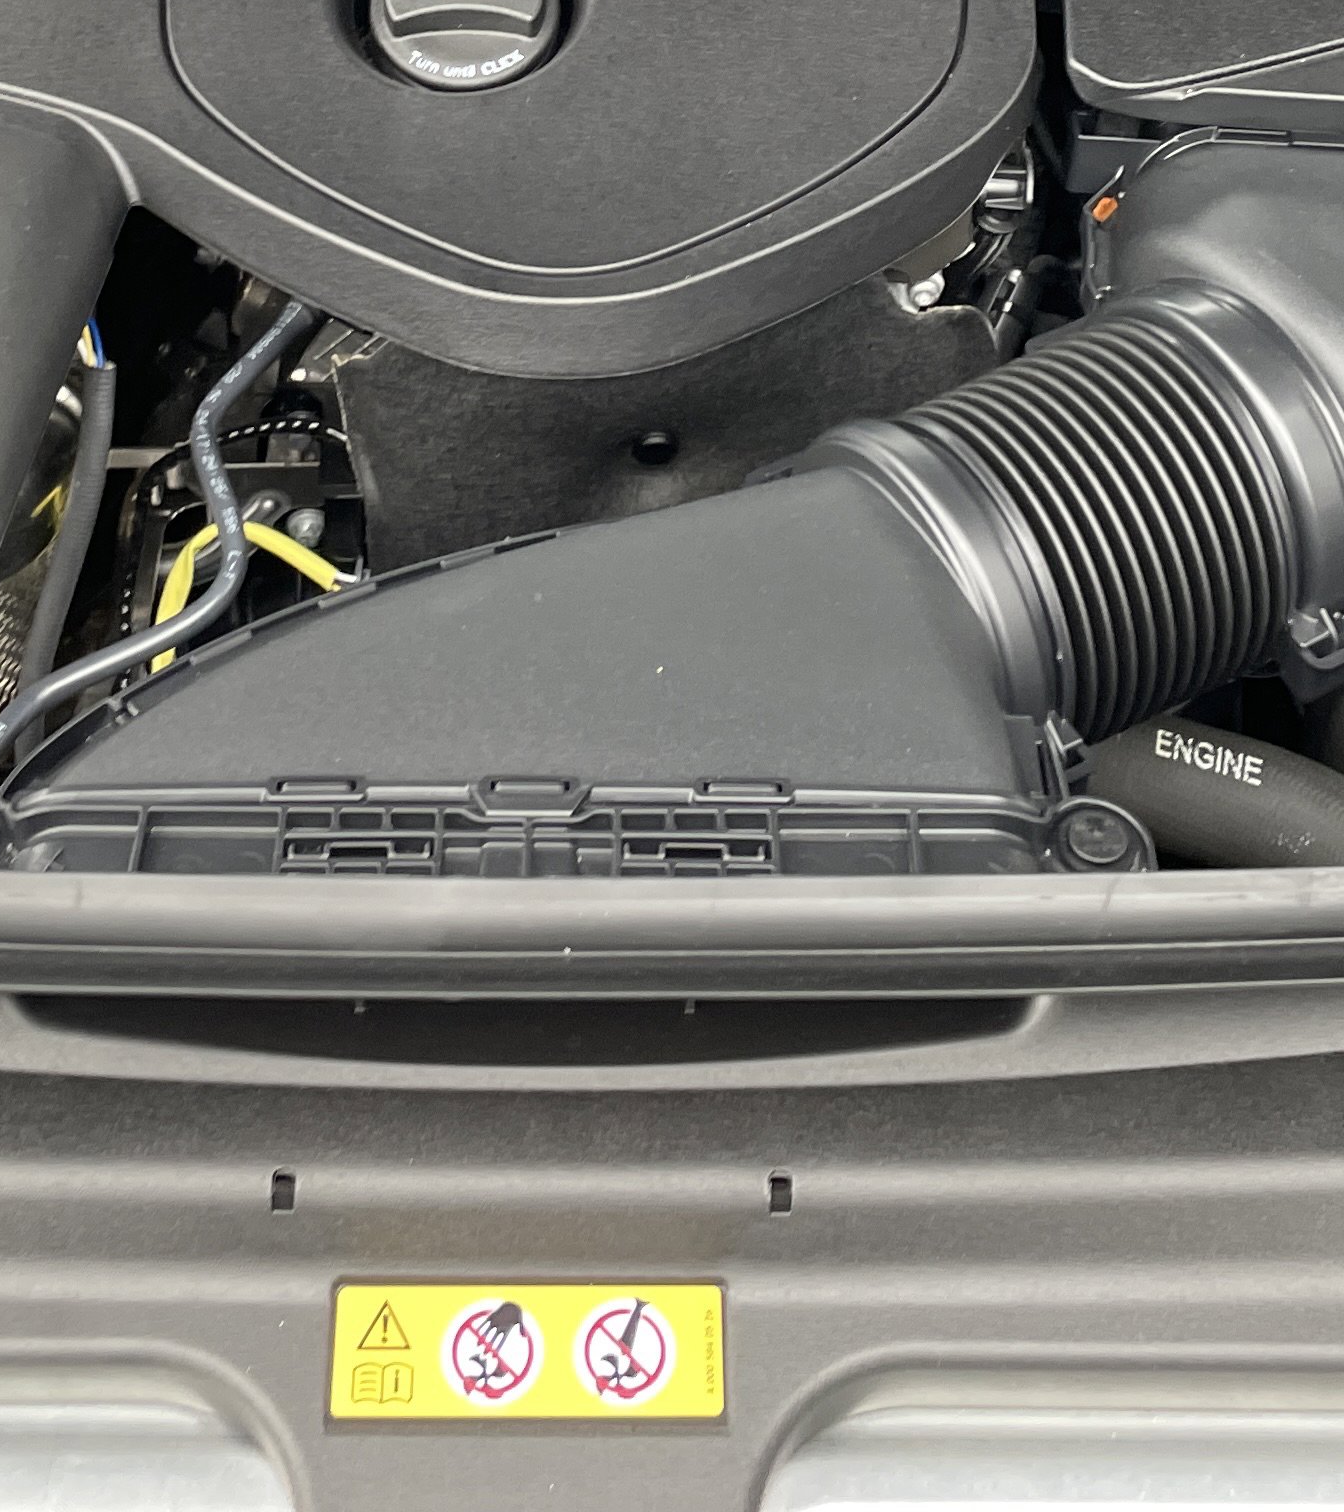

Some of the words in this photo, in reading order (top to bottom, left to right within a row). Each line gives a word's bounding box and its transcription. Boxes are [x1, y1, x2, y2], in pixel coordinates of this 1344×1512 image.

[408, 50, 439, 75] Turn
[442, 64, 476, 79] until
[480, 49, 525, 76] CLICK
[1155, 729, 1264, 786] ENGINE
